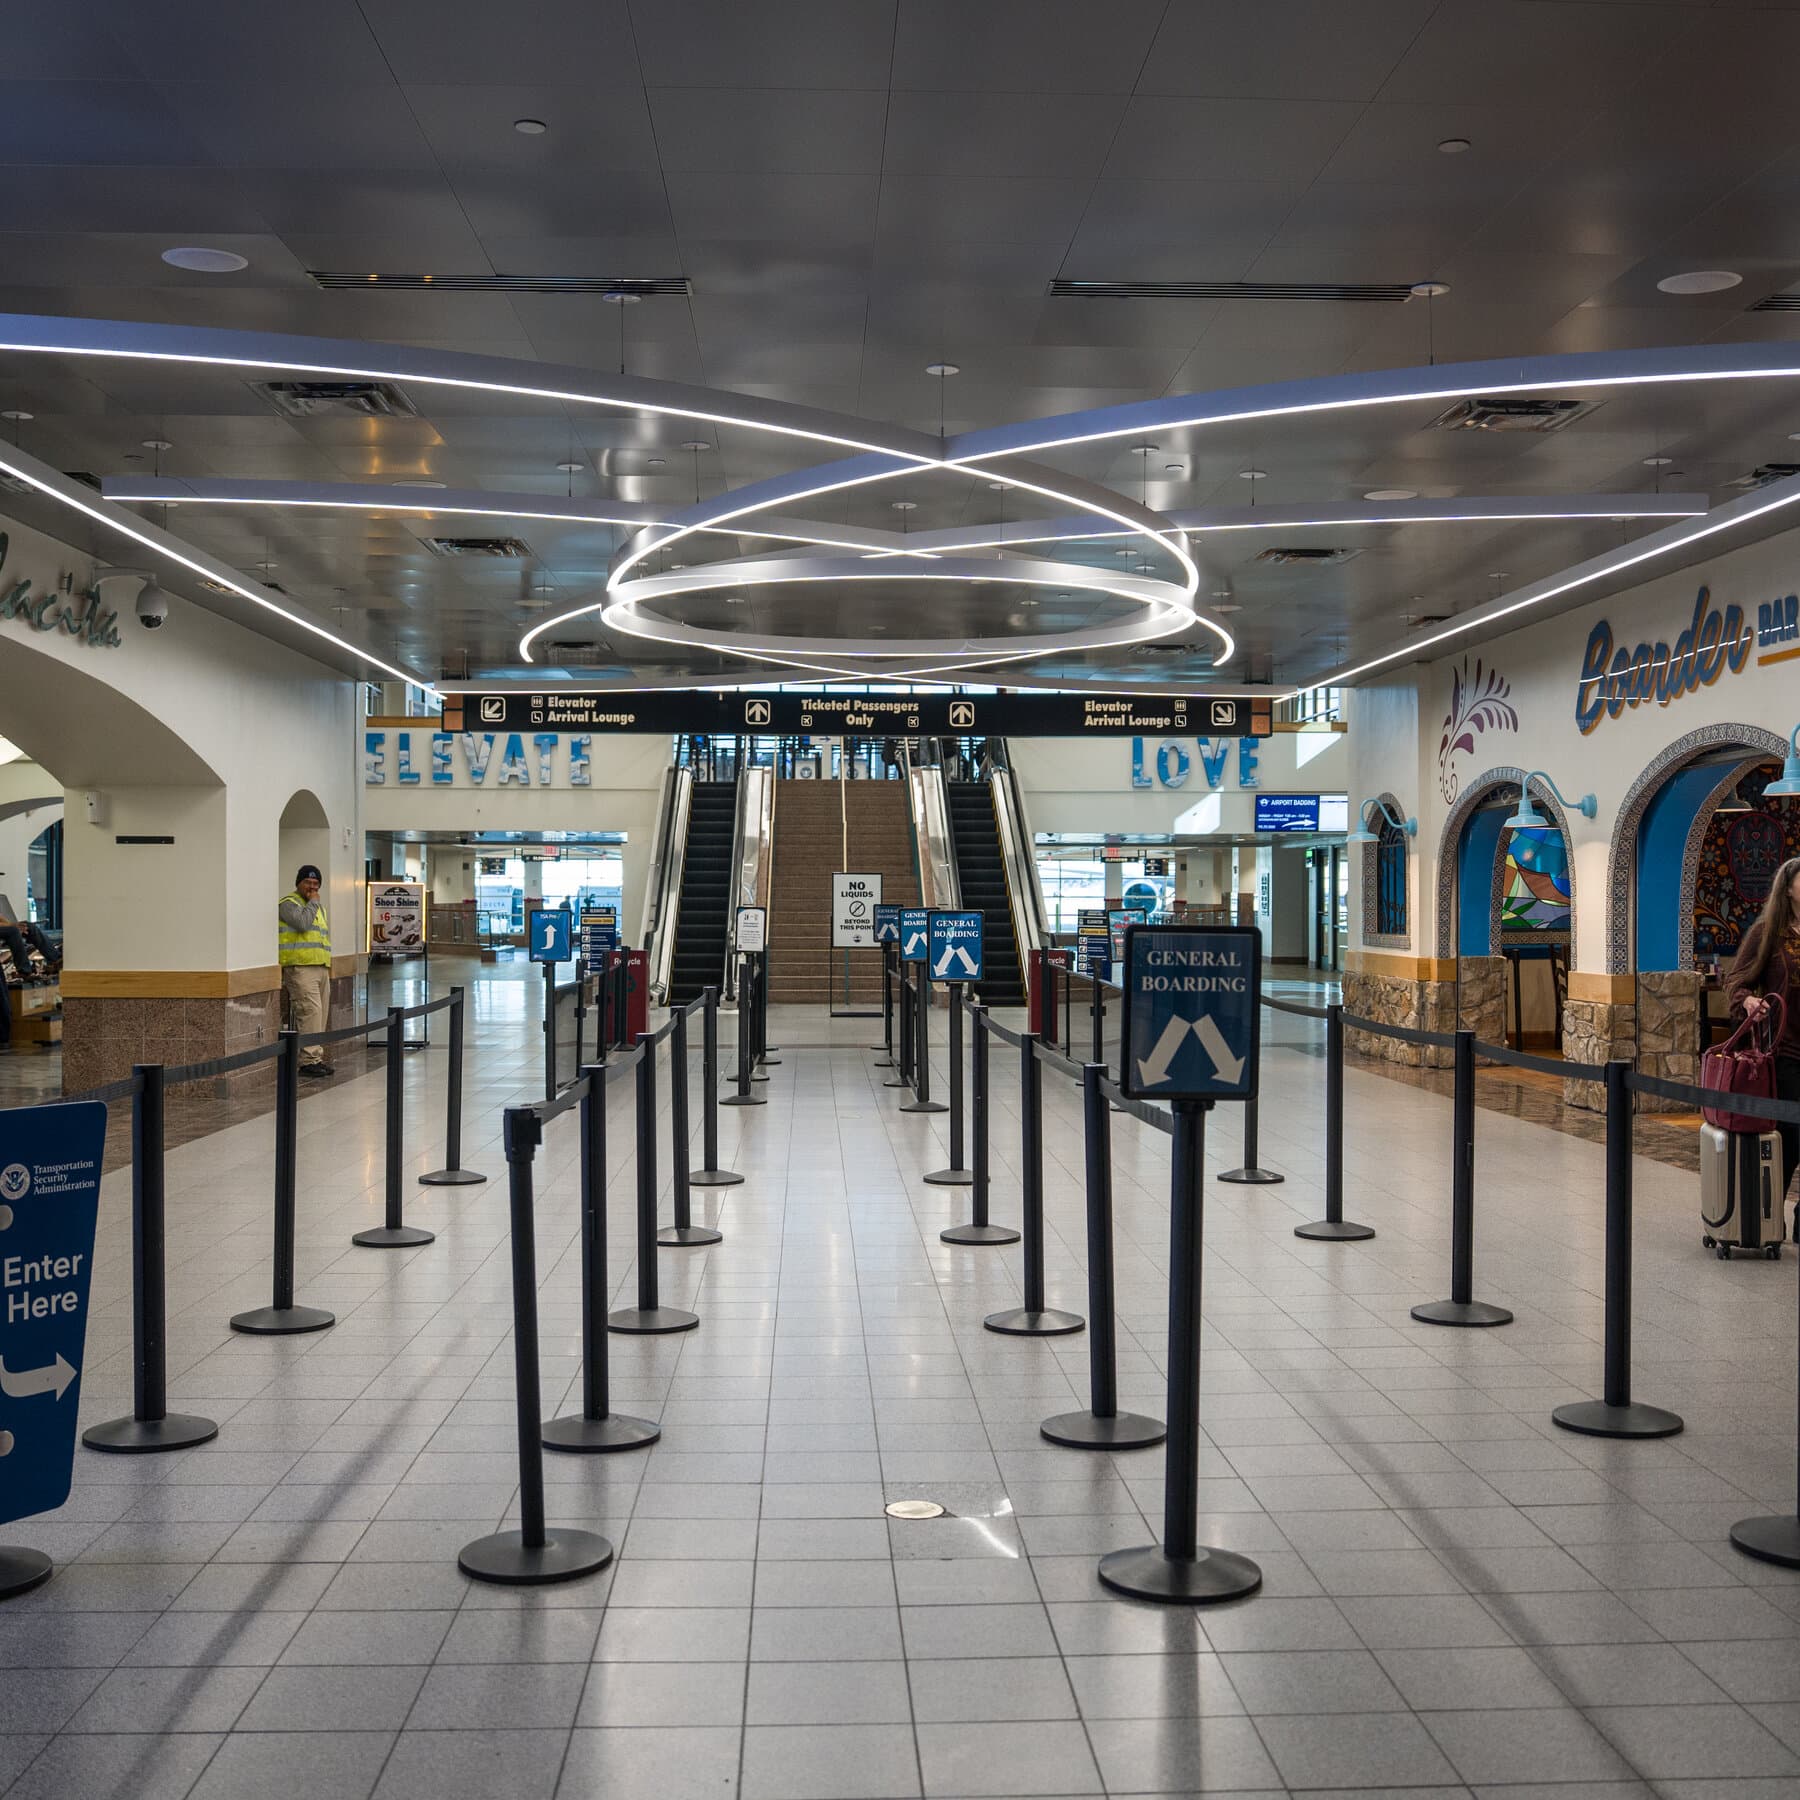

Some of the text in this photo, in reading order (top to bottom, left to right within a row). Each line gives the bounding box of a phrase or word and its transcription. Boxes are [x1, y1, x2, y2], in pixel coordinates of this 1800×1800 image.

[1575, 585, 1800, 736] Boarder BAR
[548, 696, 597, 708] Elevator
[801, 699, 919, 714] Ticketed Passengers
[1085, 701, 1133, 712] Elevator
[547, 711, 636, 725] Arrival Lounge
[846, 714, 874, 728] Only
[1085, 715, 1171, 728] Arrival Lounge
[365, 732, 592, 785] ELEVATE
[1132, 736, 1260, 788] LOVE
[849, 881, 866, 890] NO
[375, 896, 419, 906] Shoe Shine
[936, 919, 977, 927] GENERAL
[934, 930, 979, 938] BOARDING
[1146, 950, 1242, 967] GENERAL
[1141, 975, 1246, 992] BOARDING
[33, 1160, 94, 1174] Transportation
[33, 1174, 68, 1185] Security
[33, 1180, 96, 1195] Administration
[4, 1253, 83, 1288] Enter
[8, 1291, 79, 1324] Here
